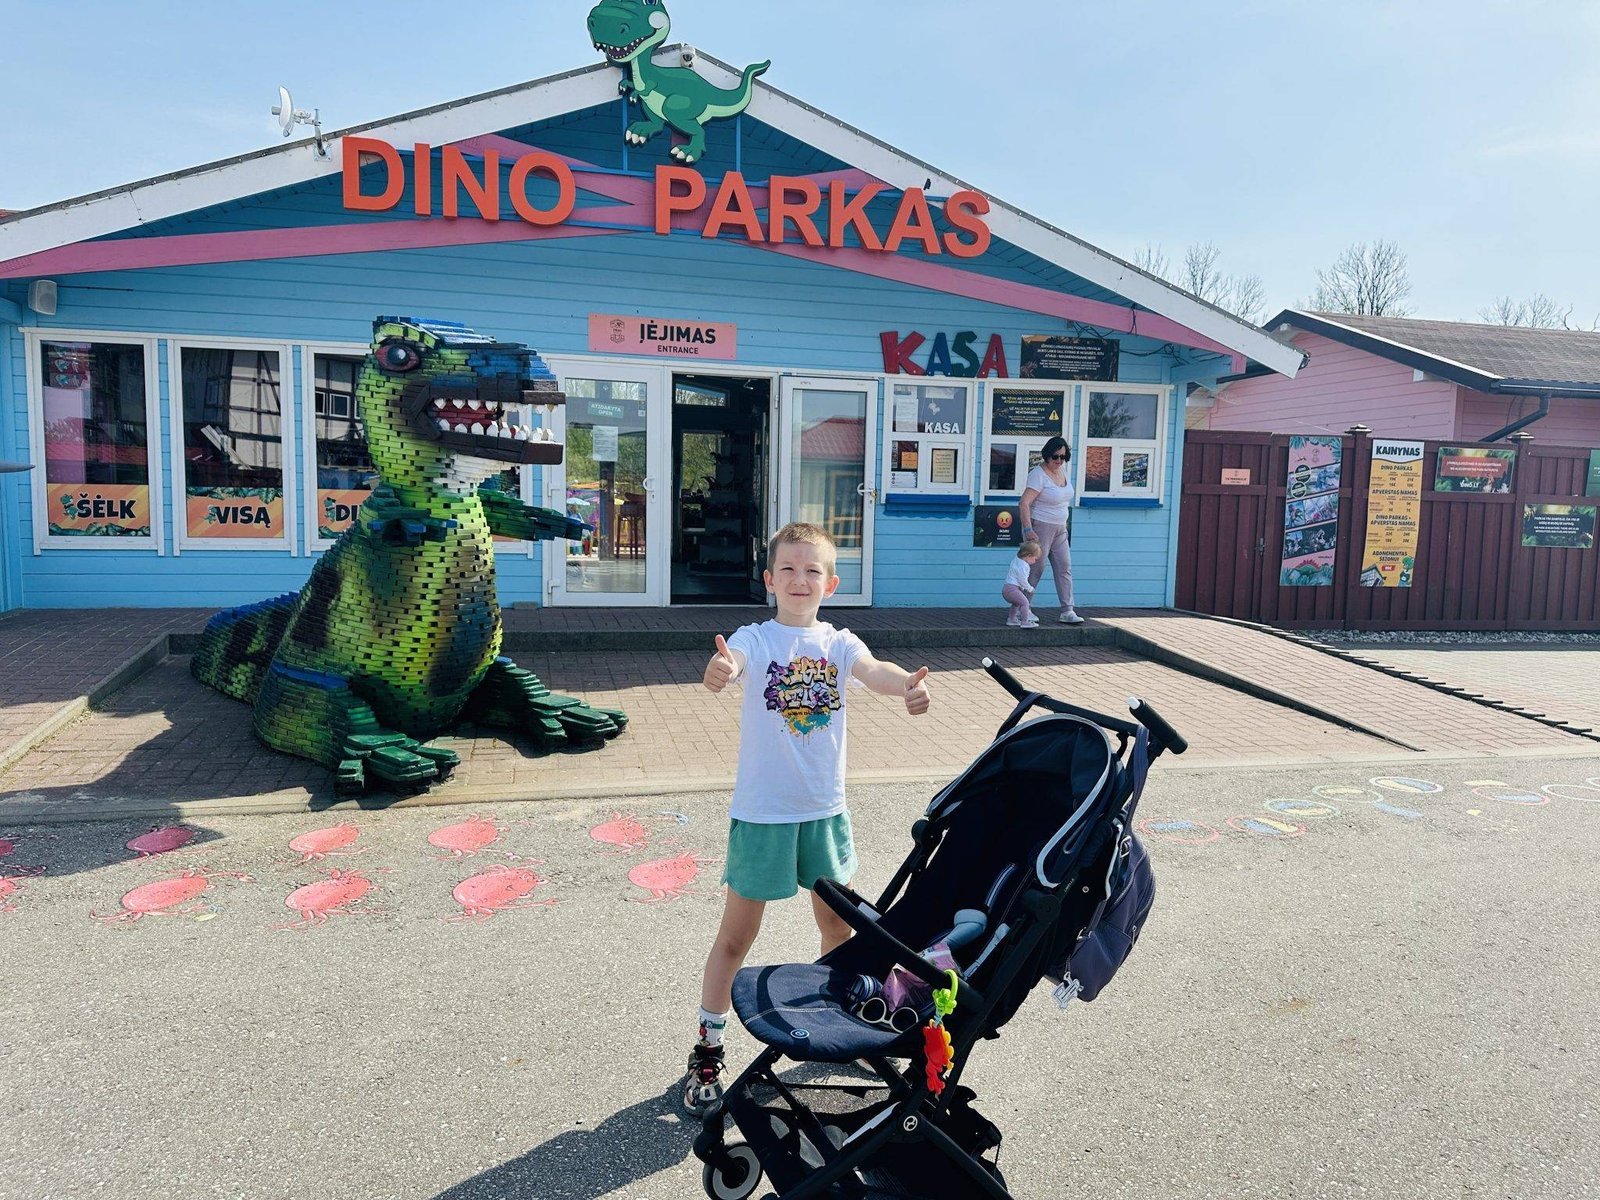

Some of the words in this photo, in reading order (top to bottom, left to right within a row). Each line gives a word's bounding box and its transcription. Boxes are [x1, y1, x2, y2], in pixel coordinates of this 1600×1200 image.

[342, 136, 576, 226] DINO
[654, 164, 991, 258] PARKAS
[640, 320, 716, 345] ĮĖJIMAS
[657, 345, 699, 355] ENTRANCE
[880, 330, 1008, 379] KASA
[924, 421, 960, 434] KASA
[1376, 446, 1420, 456] KAINYNAS
[77, 493, 136, 519] ŠĖLK
[215, 504, 271, 528] VISĄ
